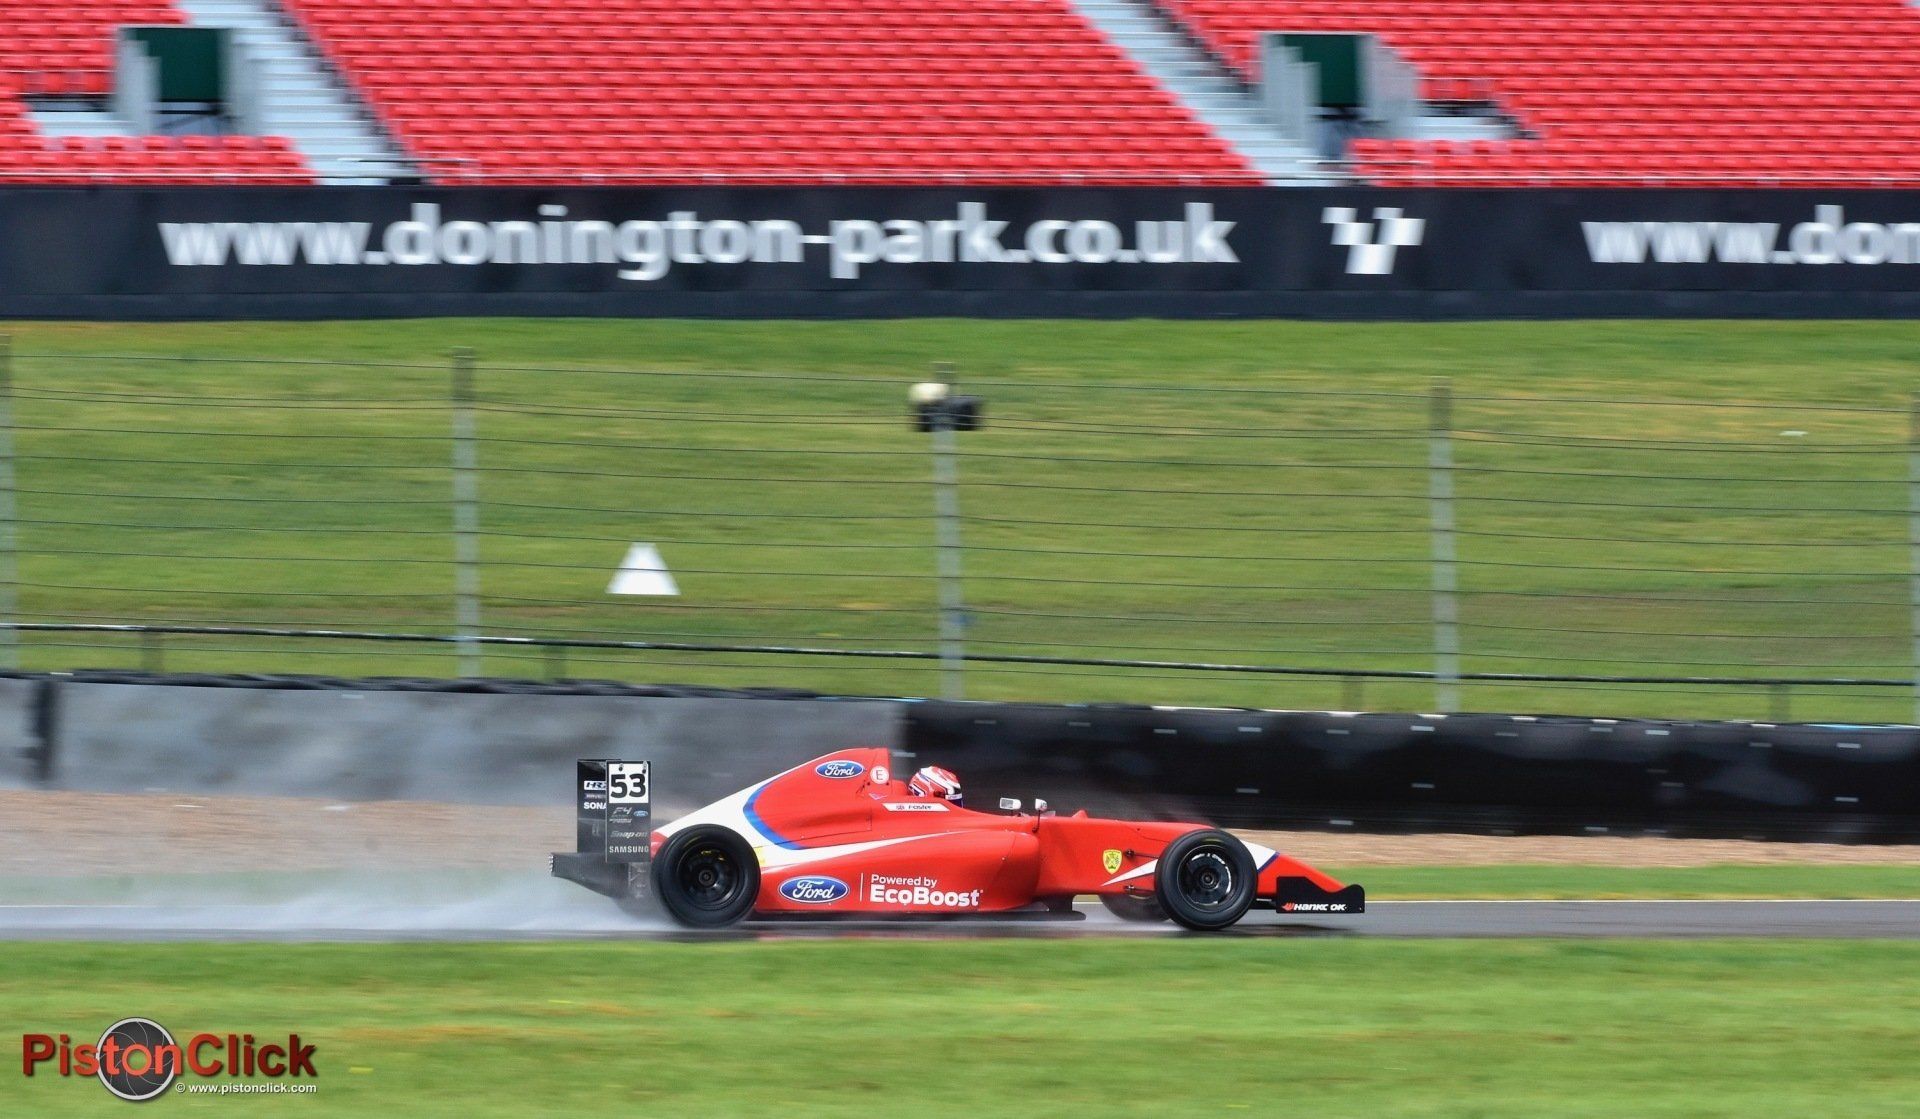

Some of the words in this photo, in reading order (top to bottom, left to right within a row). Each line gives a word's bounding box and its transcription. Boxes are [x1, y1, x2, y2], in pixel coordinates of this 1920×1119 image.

[157, 202, 1241, 281] www.donington-park.co.uk
[824, 762, 855, 776] Ford
[875, 769, 884, 781] E
[610, 773, 647, 799] 53
[609, 845, 649, 854] SAMSUNG
[792, 879, 835, 899] Ford
[871, 873, 921, 886] Powered
[923, 876, 938, 889] by
[870, 883, 980, 907] EcoBoost
